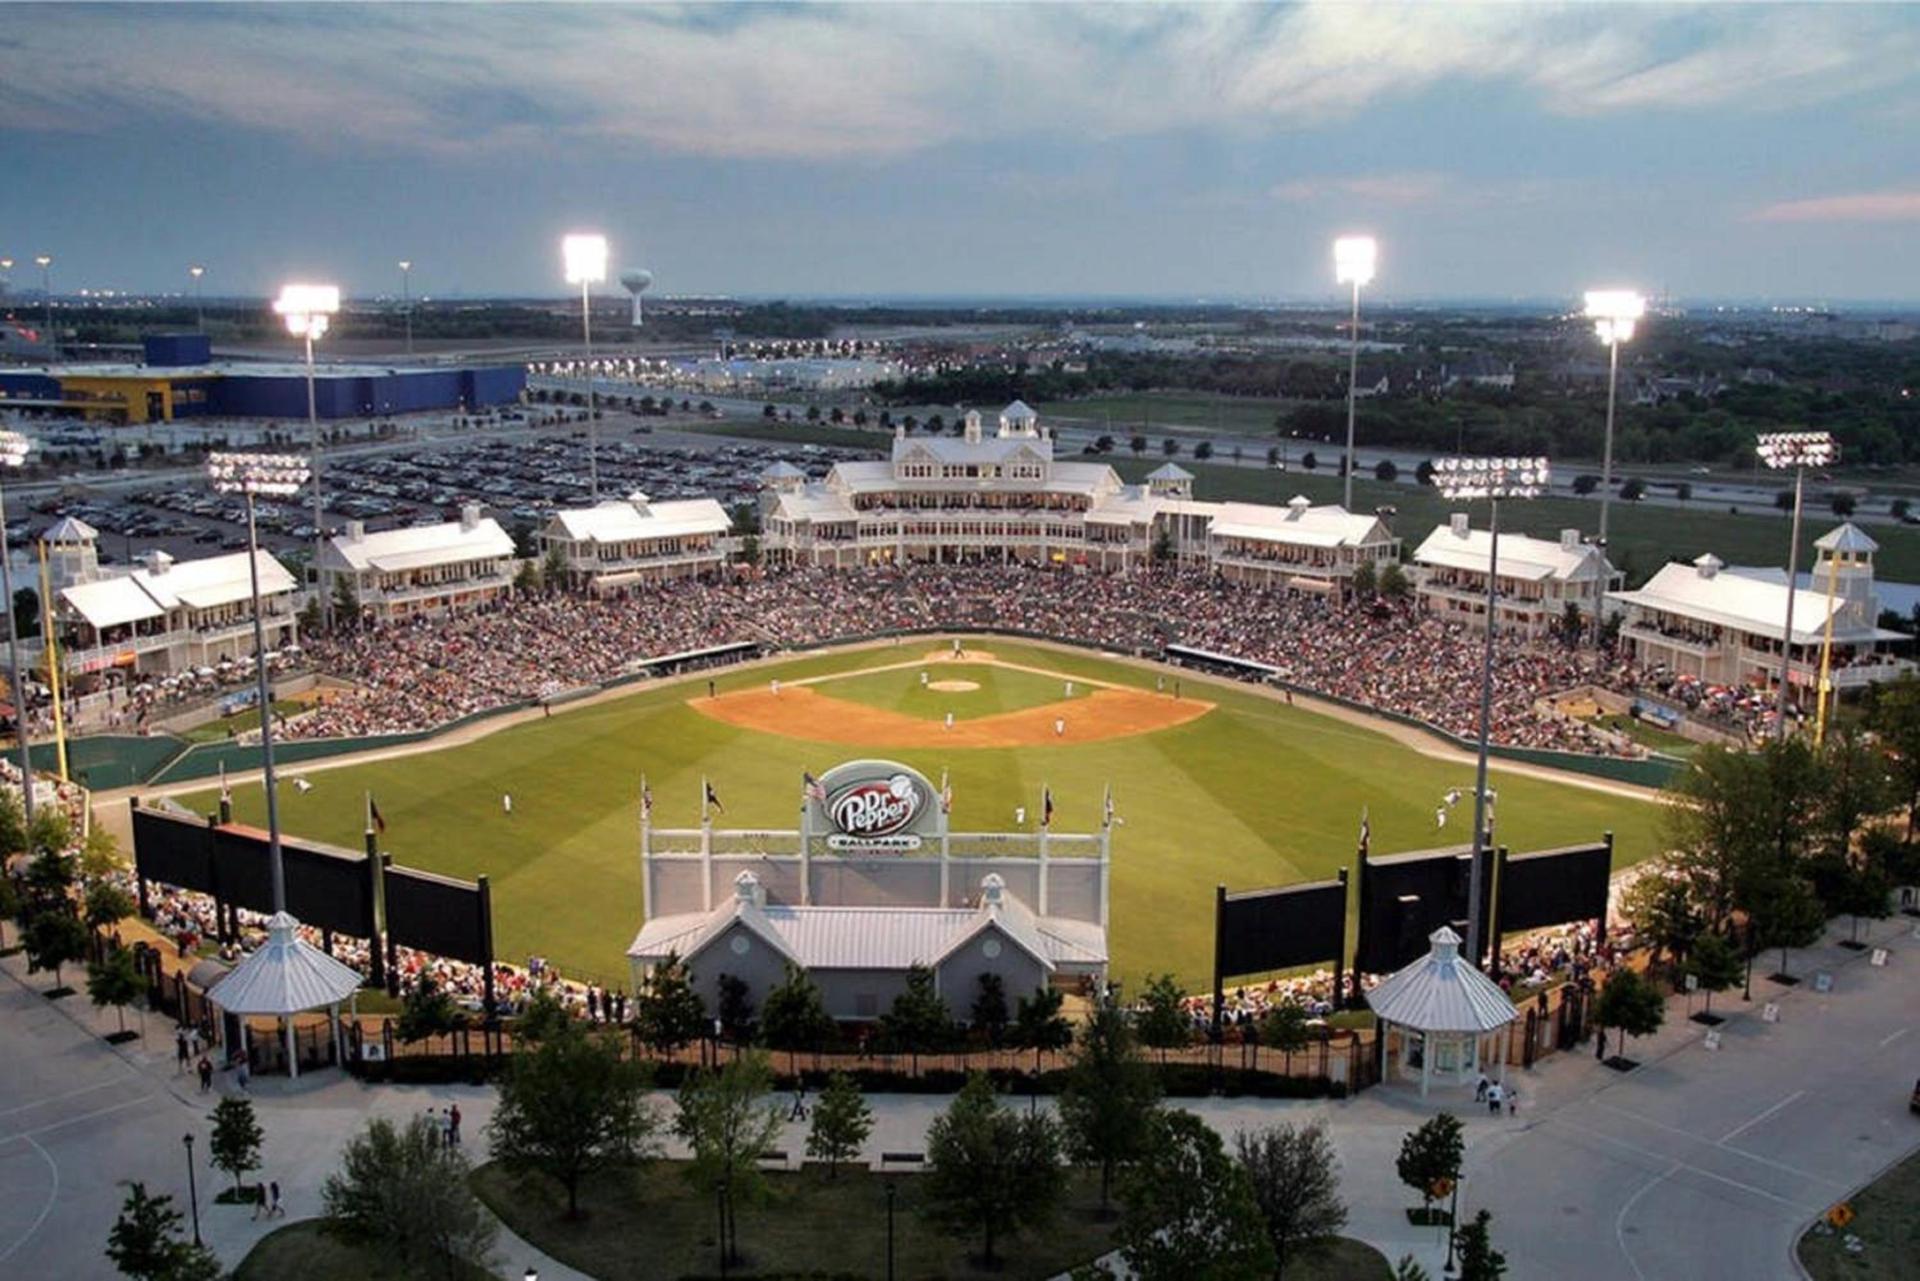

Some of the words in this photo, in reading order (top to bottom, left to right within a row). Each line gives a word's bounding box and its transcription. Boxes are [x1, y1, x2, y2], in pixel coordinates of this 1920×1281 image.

[864, 791, 891, 811] Dr
[837, 796, 909, 832] Pepper
[839, 839, 909, 847] BALLPARK
